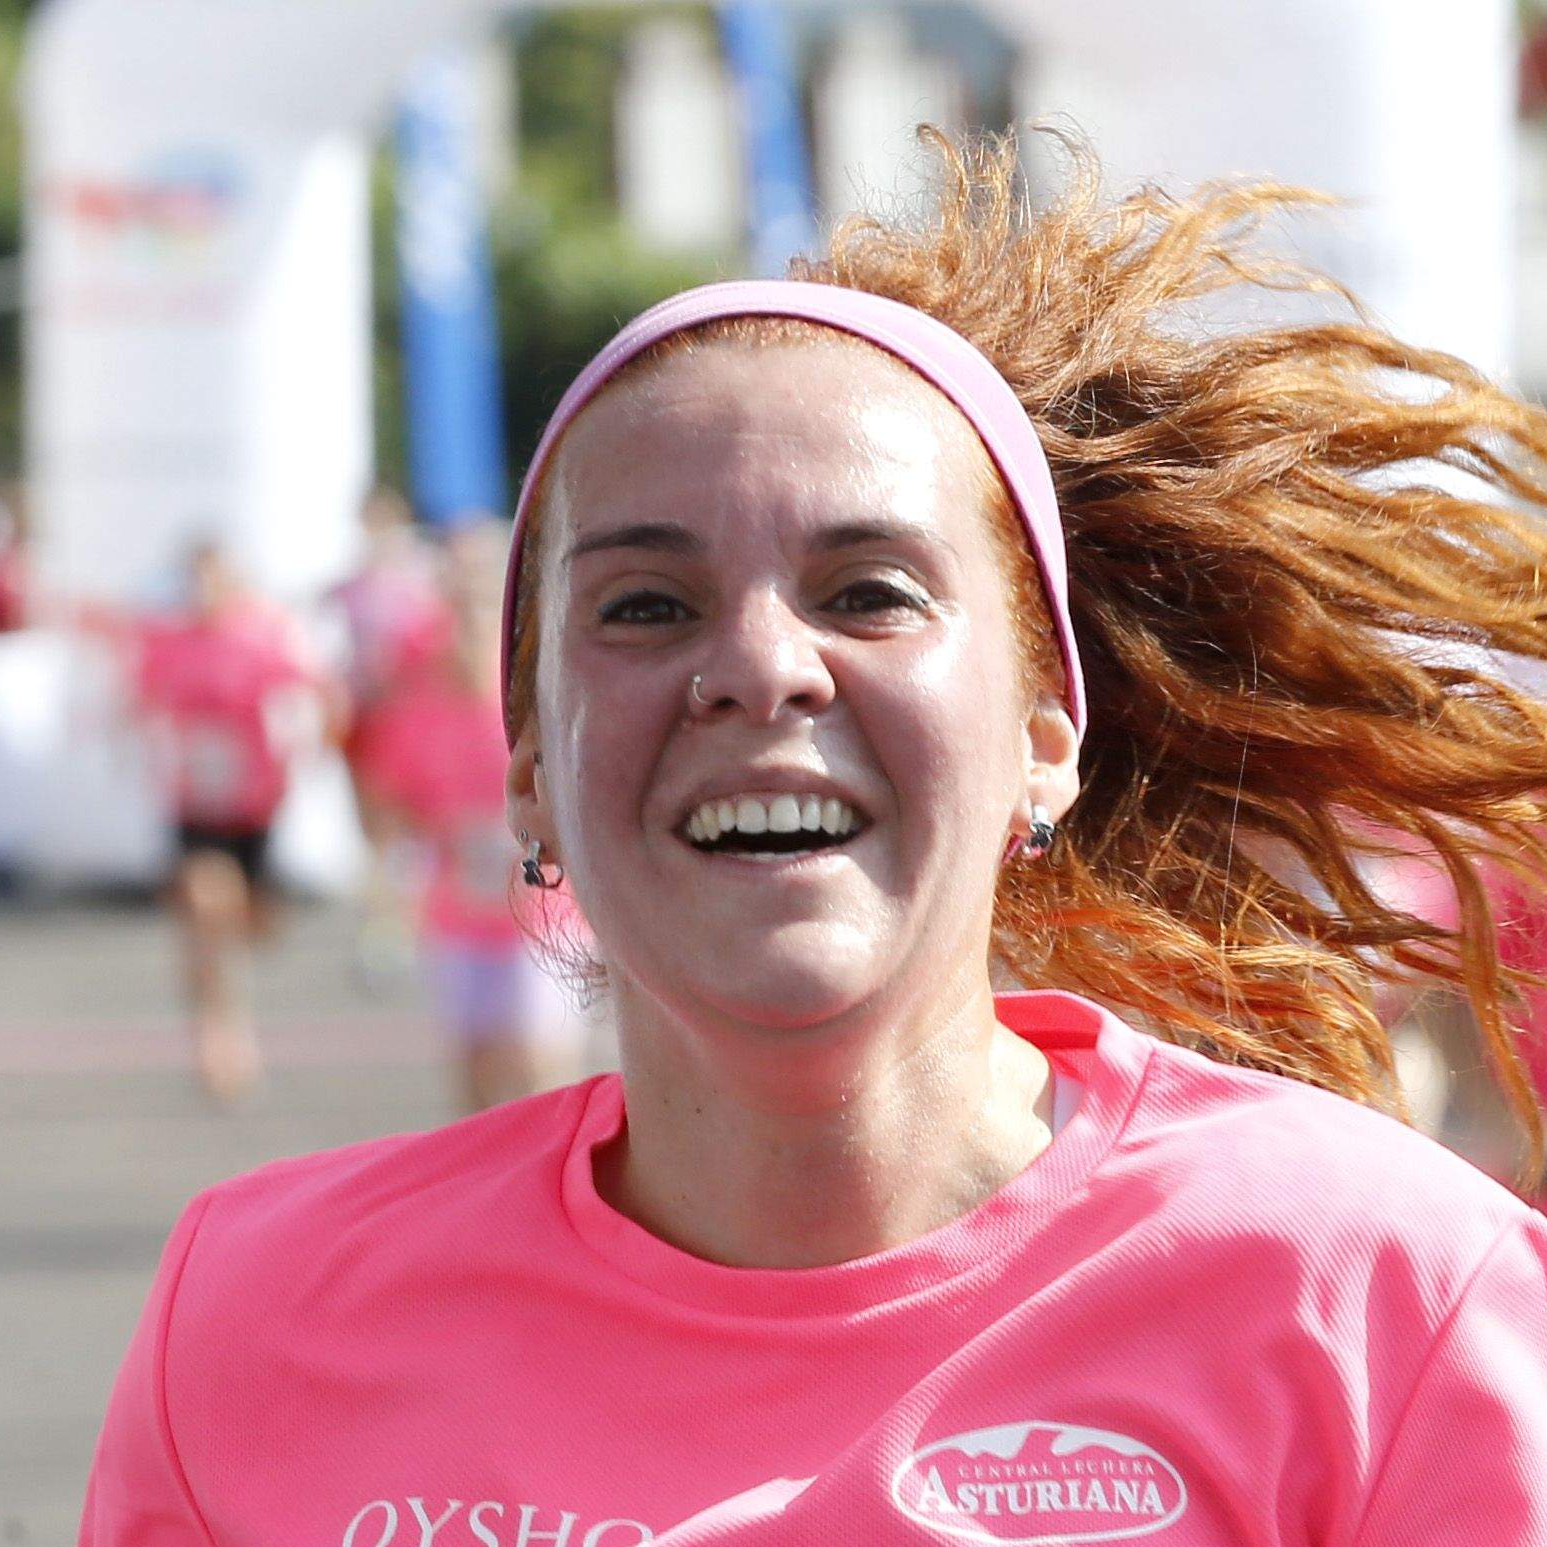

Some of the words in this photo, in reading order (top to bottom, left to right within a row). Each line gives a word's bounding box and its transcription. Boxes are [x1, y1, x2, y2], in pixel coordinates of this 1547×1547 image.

[958, 1461, 1053, 1478] CENTRAL
[1061, 1459, 1156, 1477] LECHERA
[916, 1465, 1168, 1516] ASTURIANA
